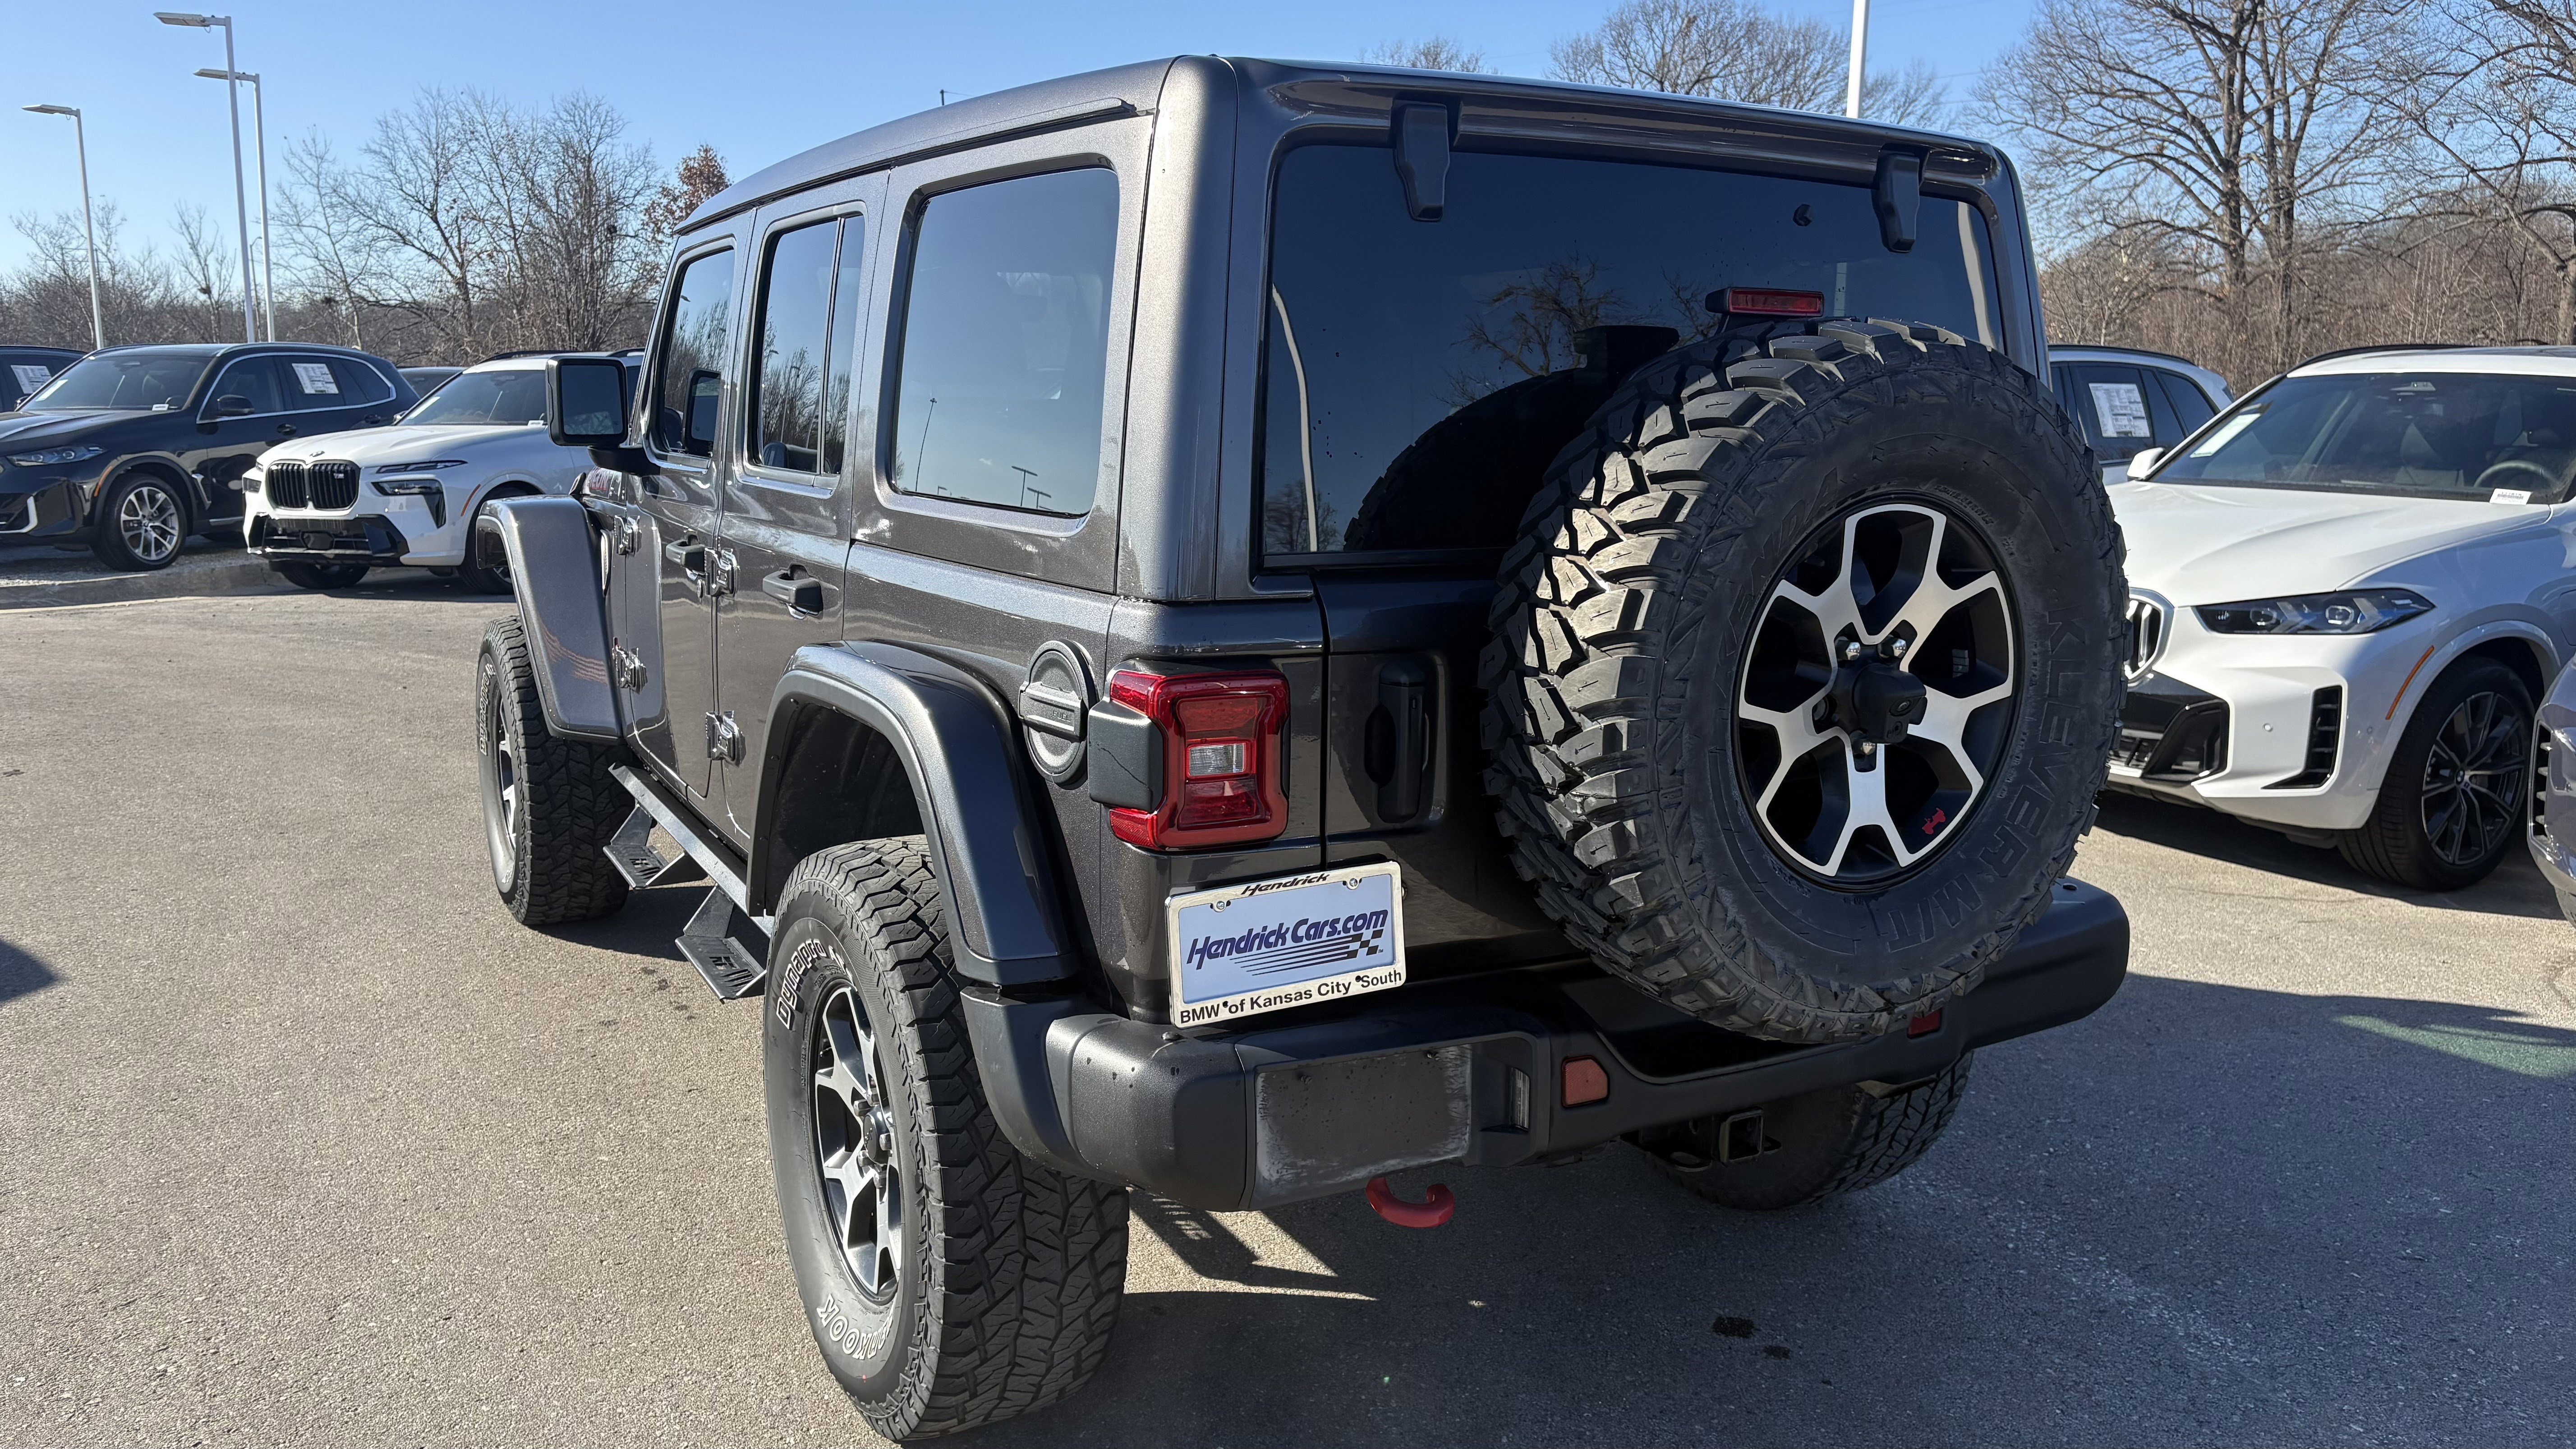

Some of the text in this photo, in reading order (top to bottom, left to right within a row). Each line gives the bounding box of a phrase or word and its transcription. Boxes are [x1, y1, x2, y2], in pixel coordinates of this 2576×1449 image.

[479, 672, 489, 756] Dynapro
[1053, 710, 1071, 722] FUEL
[1887, 607, 2090, 953] KLEVER M/T
[1241, 873, 1330, 897] Hendrick
[1187, 909, 1389, 970] HendrickCars.com
[776, 938, 827, 1030] Dynapro
[1180, 970, 1402, 1024] BMW of Kansas City South
